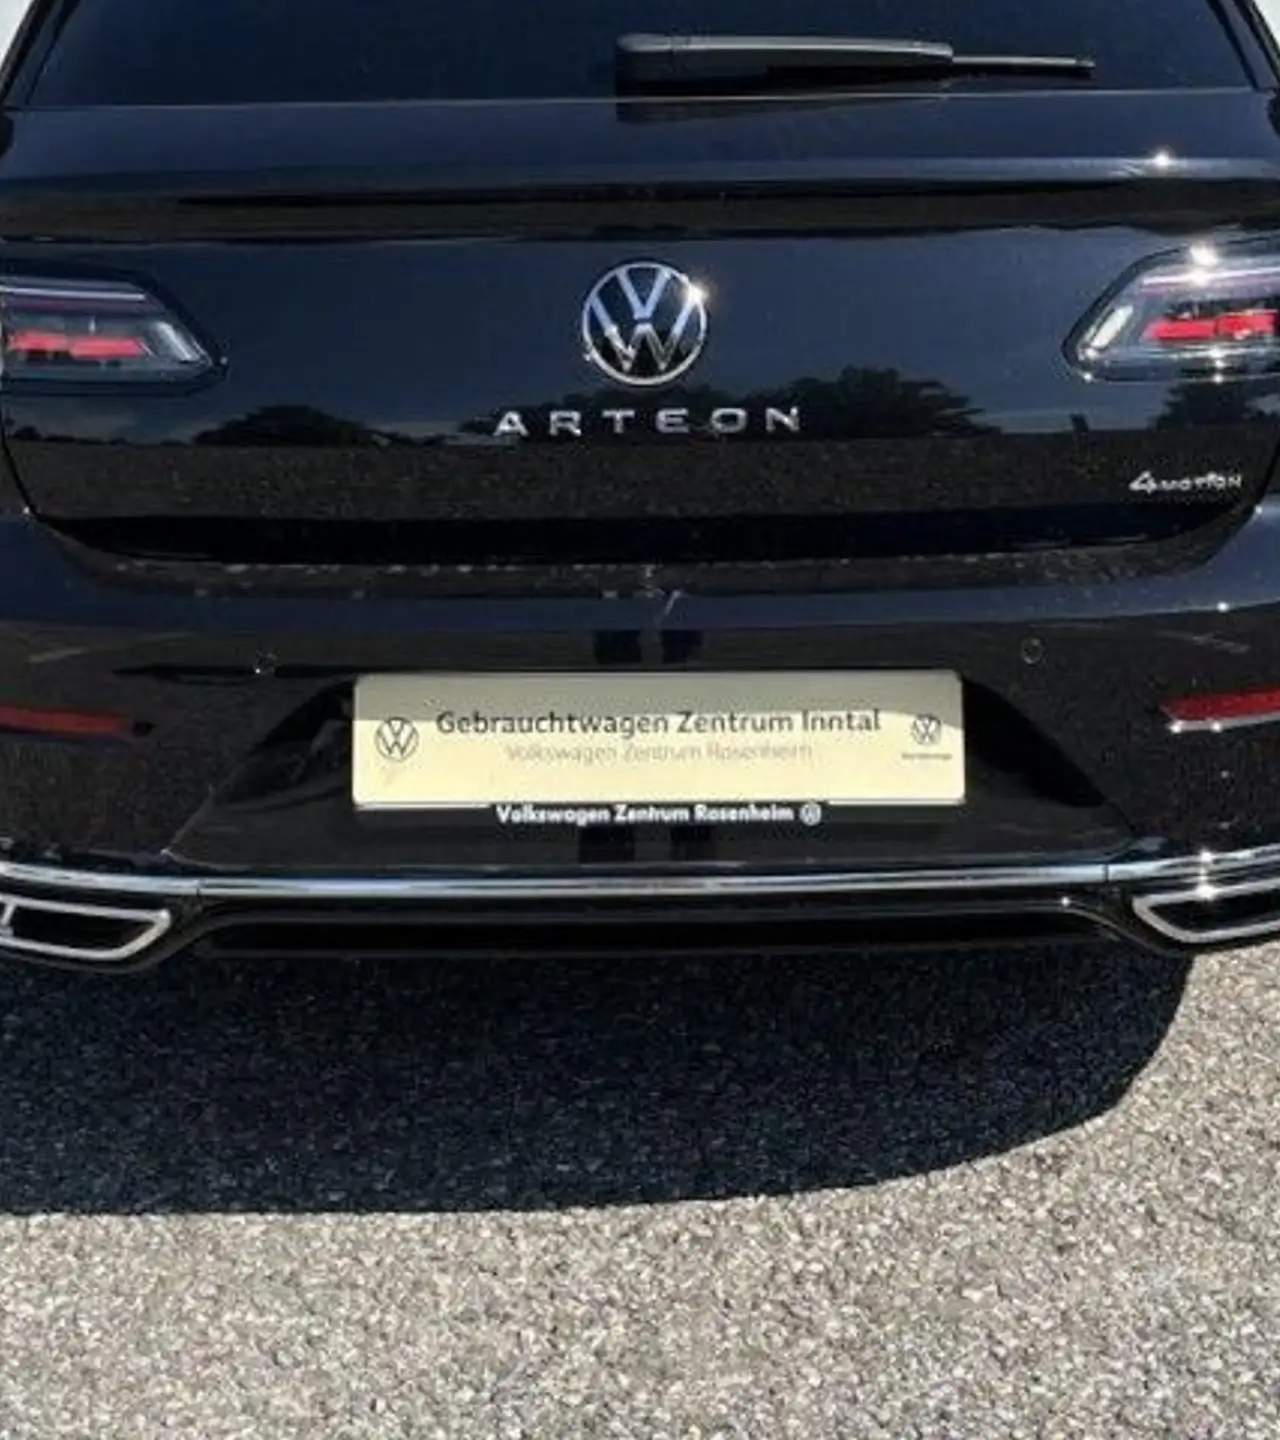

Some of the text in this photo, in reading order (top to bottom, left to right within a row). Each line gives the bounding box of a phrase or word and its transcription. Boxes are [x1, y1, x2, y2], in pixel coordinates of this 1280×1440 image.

[493, 407, 801, 437] ARTEON
[1128, 470, 1242, 496] 4MOTION
[435, 709, 882, 737] Gebrauchtwagen Zentrum Inntal
[495, 804, 611, 826] Volkswagen
[614, 804, 691, 822] Zentrum
[694, 803, 795, 822] Rosenheim
